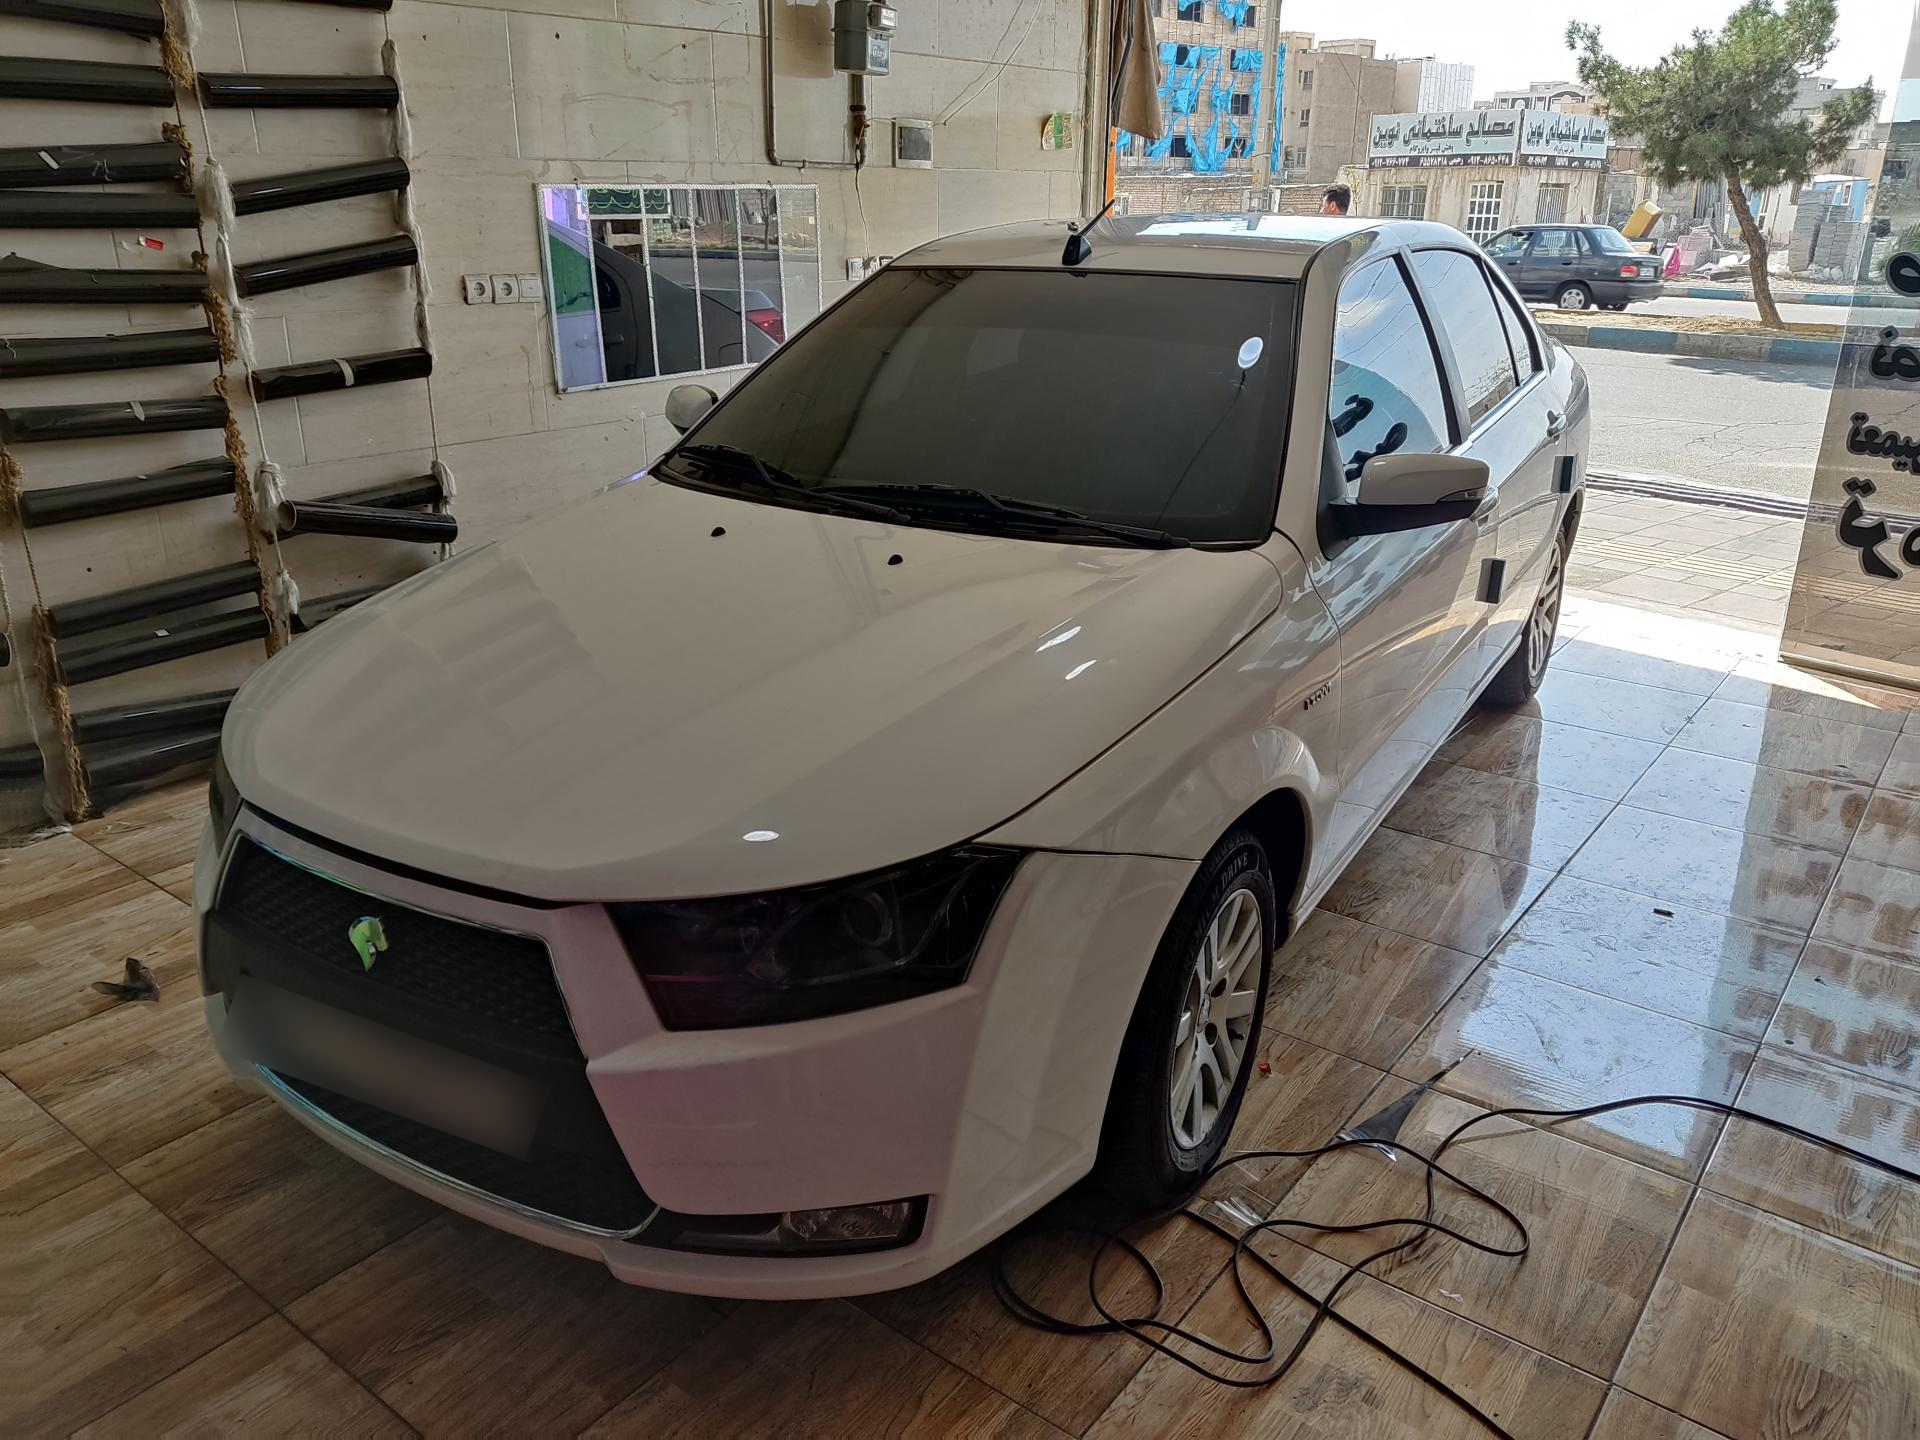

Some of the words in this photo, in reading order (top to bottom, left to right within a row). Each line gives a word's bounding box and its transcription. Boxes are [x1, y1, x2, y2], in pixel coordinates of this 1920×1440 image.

[1373, 121, 1401, 148] نوین
[1402, 113, 1464, 146] ساختمانی
[1465, 110, 1516, 146] مصالح
